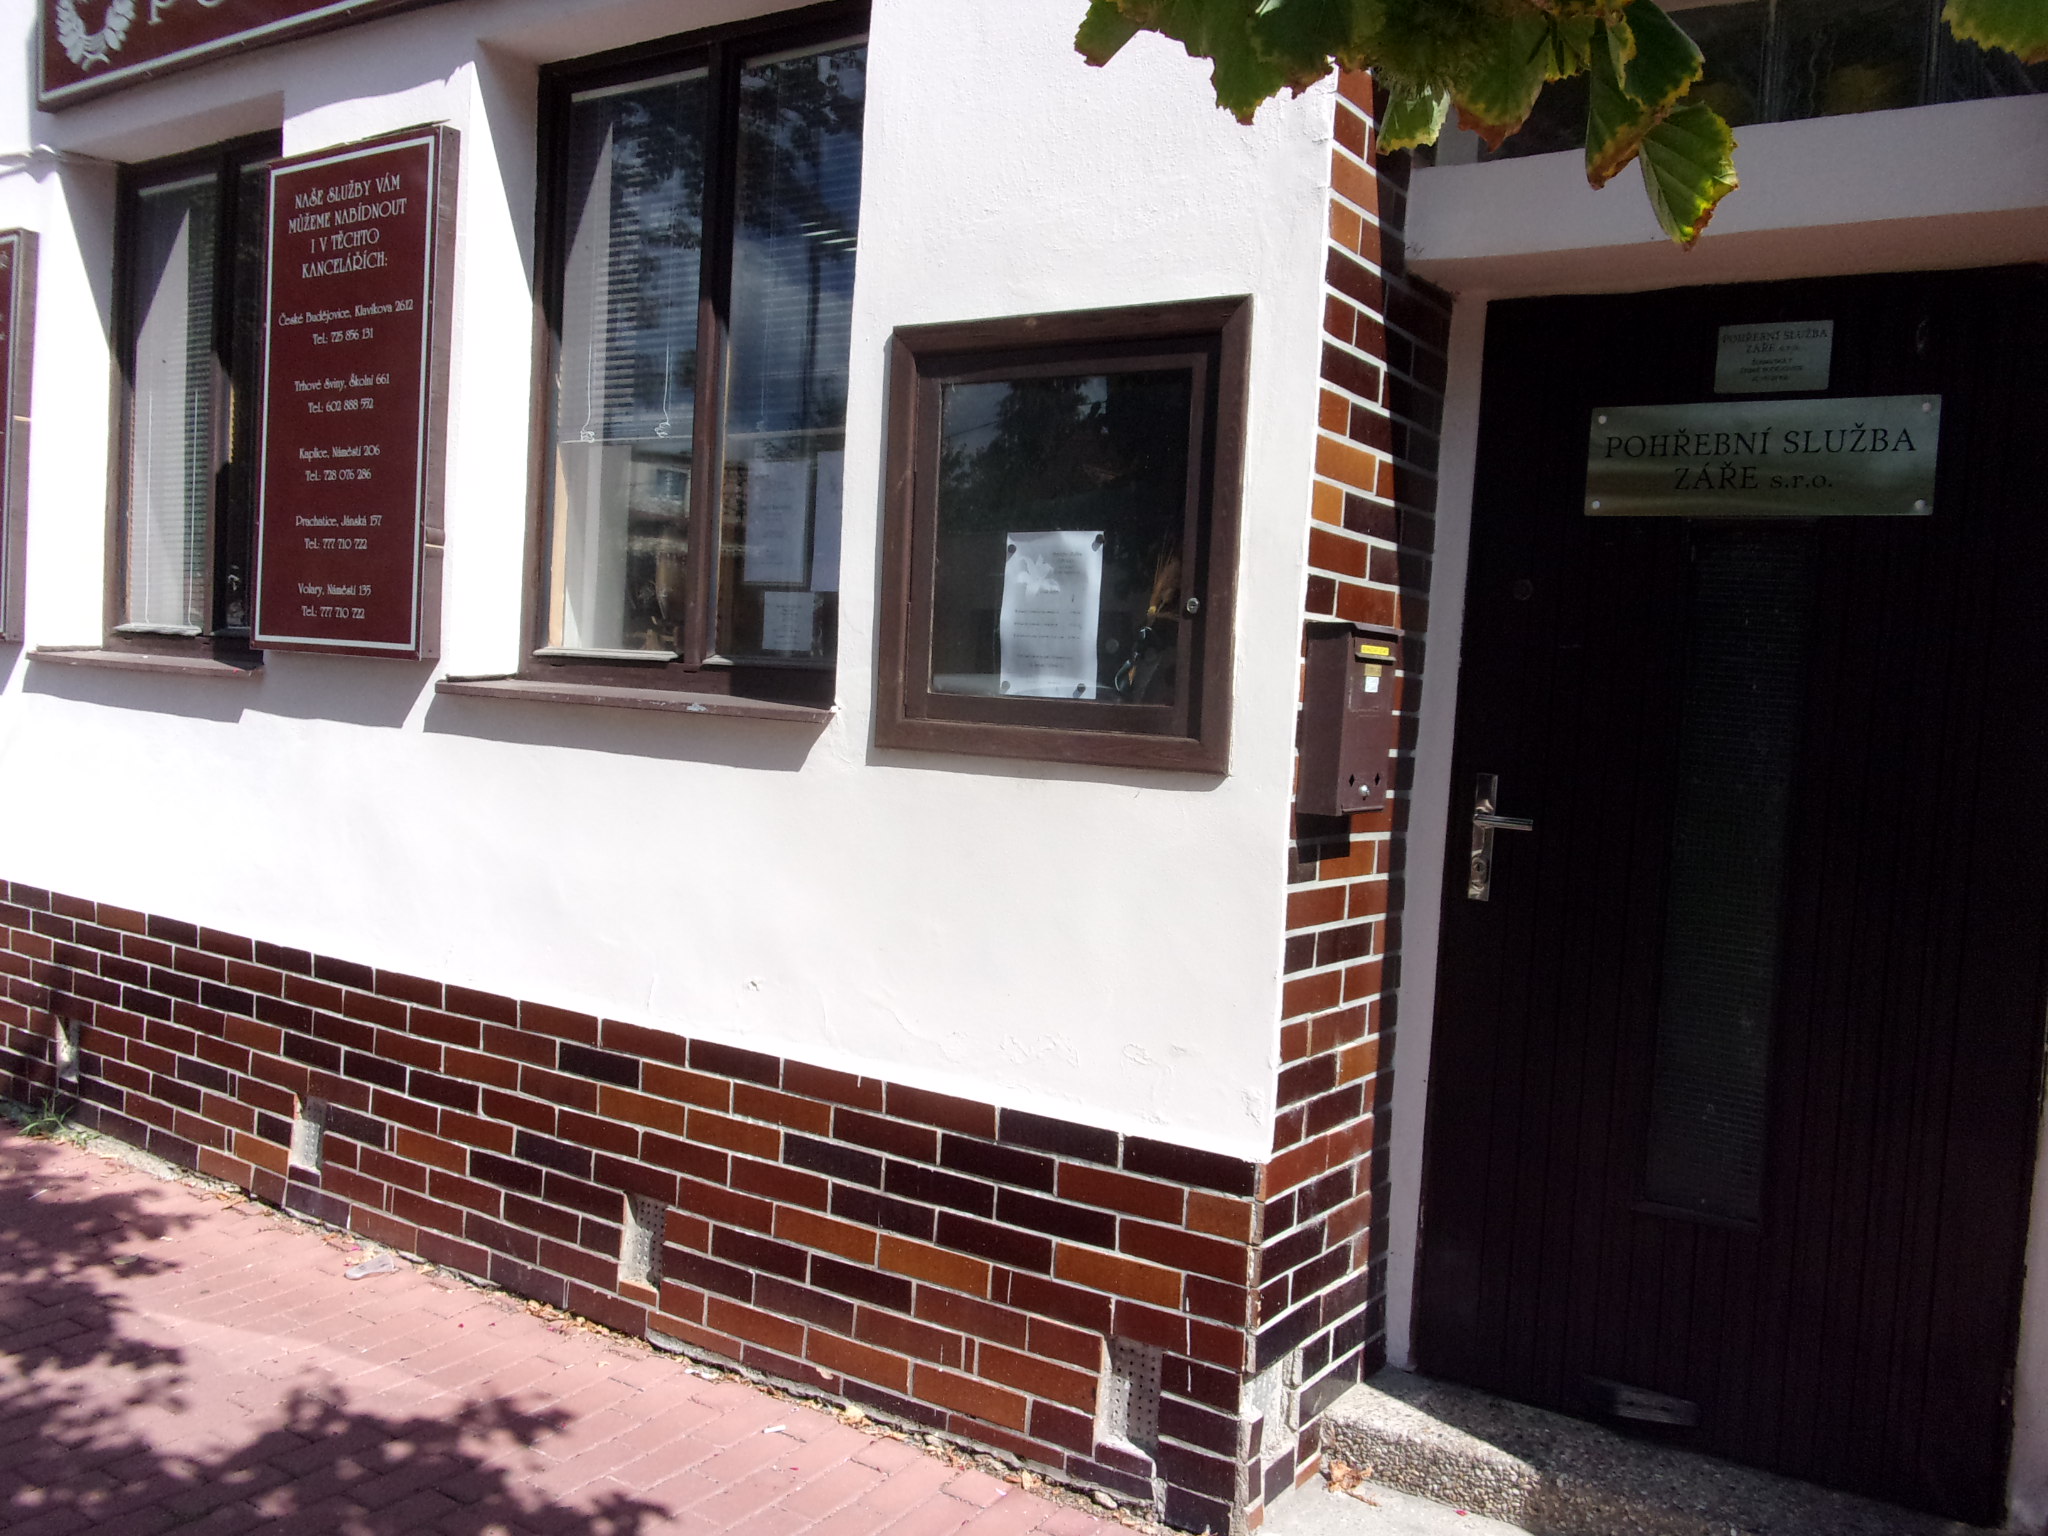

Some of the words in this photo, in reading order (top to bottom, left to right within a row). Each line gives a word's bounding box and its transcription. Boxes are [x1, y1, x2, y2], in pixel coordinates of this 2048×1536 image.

[295, 187, 324, 209] NAŠE
[327, 179, 371, 203] SLUŽBY
[375, 172, 401, 194] VÁM
[289, 212, 331, 234] MŮŽEME
[334, 198, 408, 226] NABÍDNOUT
[311, 239, 315, 254] I
[319, 237, 328, 252] V
[331, 230, 380, 250] TĚCHTO
[302, 250, 388, 278] KANCELÁŘÍCH:
[278, 312, 304, 327] České
[395, 299, 414, 312] 2612
[294, 379, 322, 392] Trhové
[375, 372, 390, 385] 661
[325, 400, 342, 412] 602
[343, 398, 359, 410] 888
[363, 444, 381, 456] 206
[1604, 427, 1773, 458] POHŘEBNÍ
[1783, 422, 1916, 454] SLUŽBA
[338, 468, 355, 480] 076
[1674, 462, 1758, 490] ZÁŘE
[1770, 474, 1833, 489] s.r.o.
[295, 515, 339, 527] Prachatice,
[322, 538, 336, 549] 777
[337, 538, 352, 549] 710
[297, 582, 325, 598] Volary,
[319, 606, 333, 618] 777
[335, 606, 350, 619] 710
